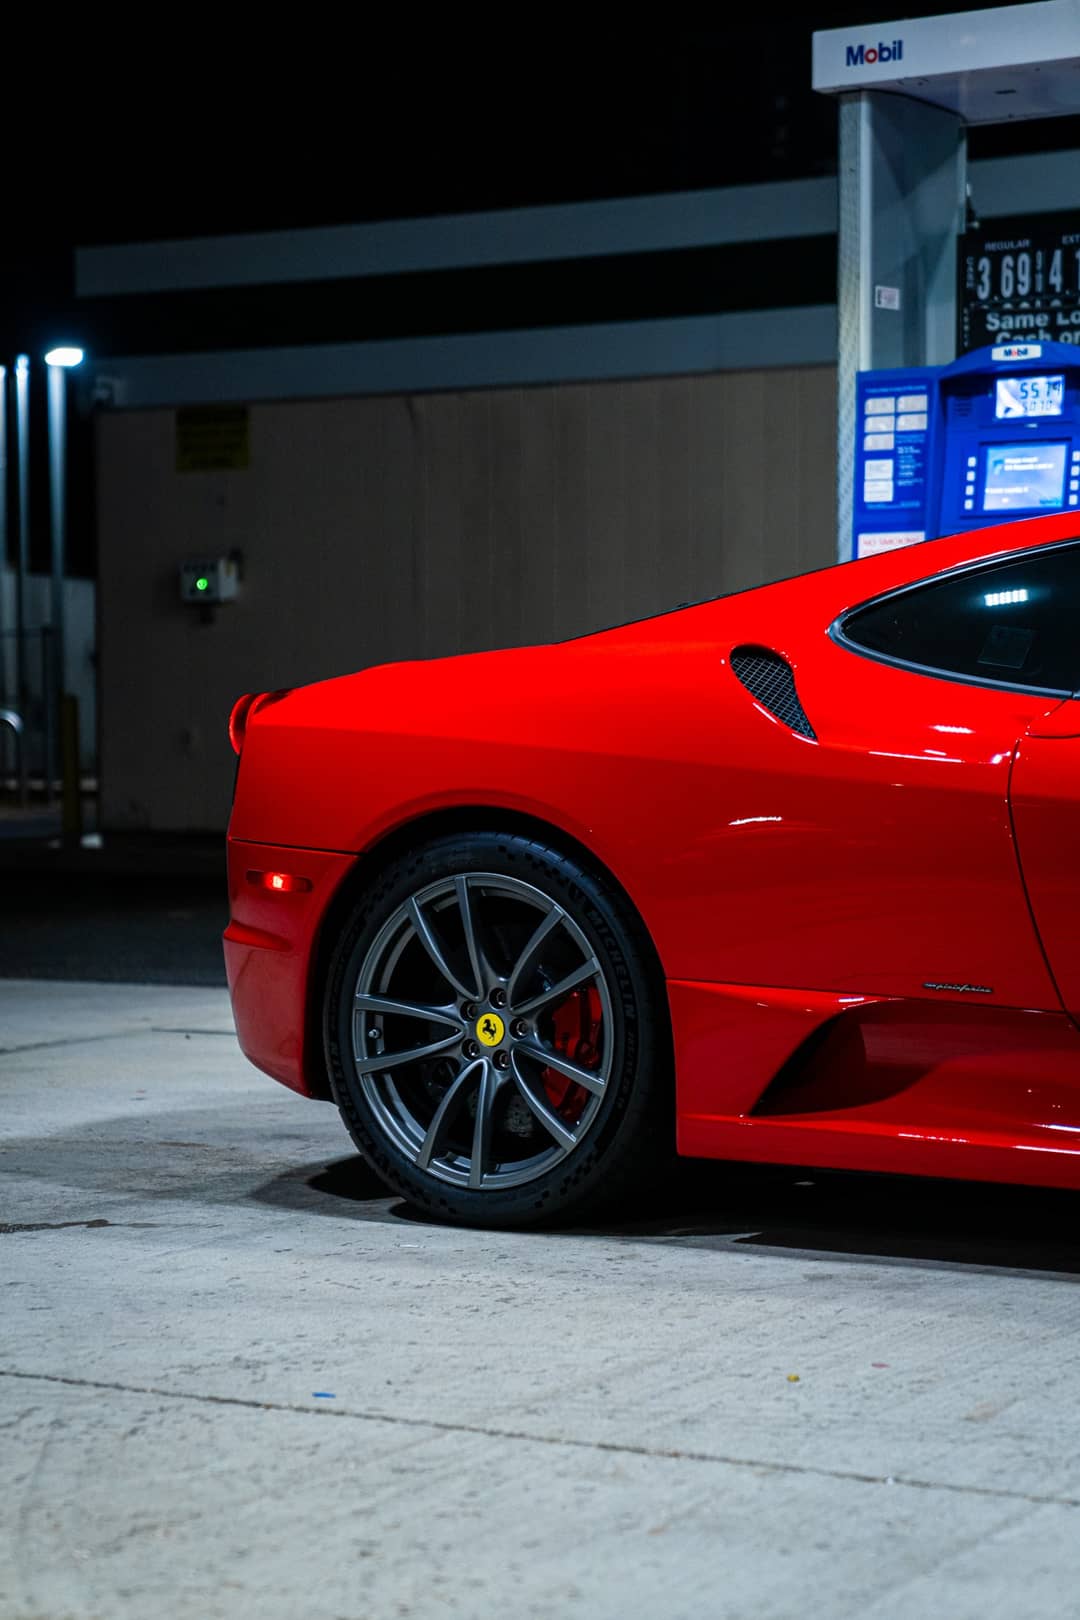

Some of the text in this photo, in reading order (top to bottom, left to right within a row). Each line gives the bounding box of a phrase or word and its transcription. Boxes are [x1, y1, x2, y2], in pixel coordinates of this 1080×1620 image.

[846, 40, 903, 67] Mobil
[984, 239, 1031, 251] REGULAR
[985, 311, 1049, 331] Same
[1003, 347, 1028, 357] Mobil
[588, 907, 637, 1022] MICHELIN
